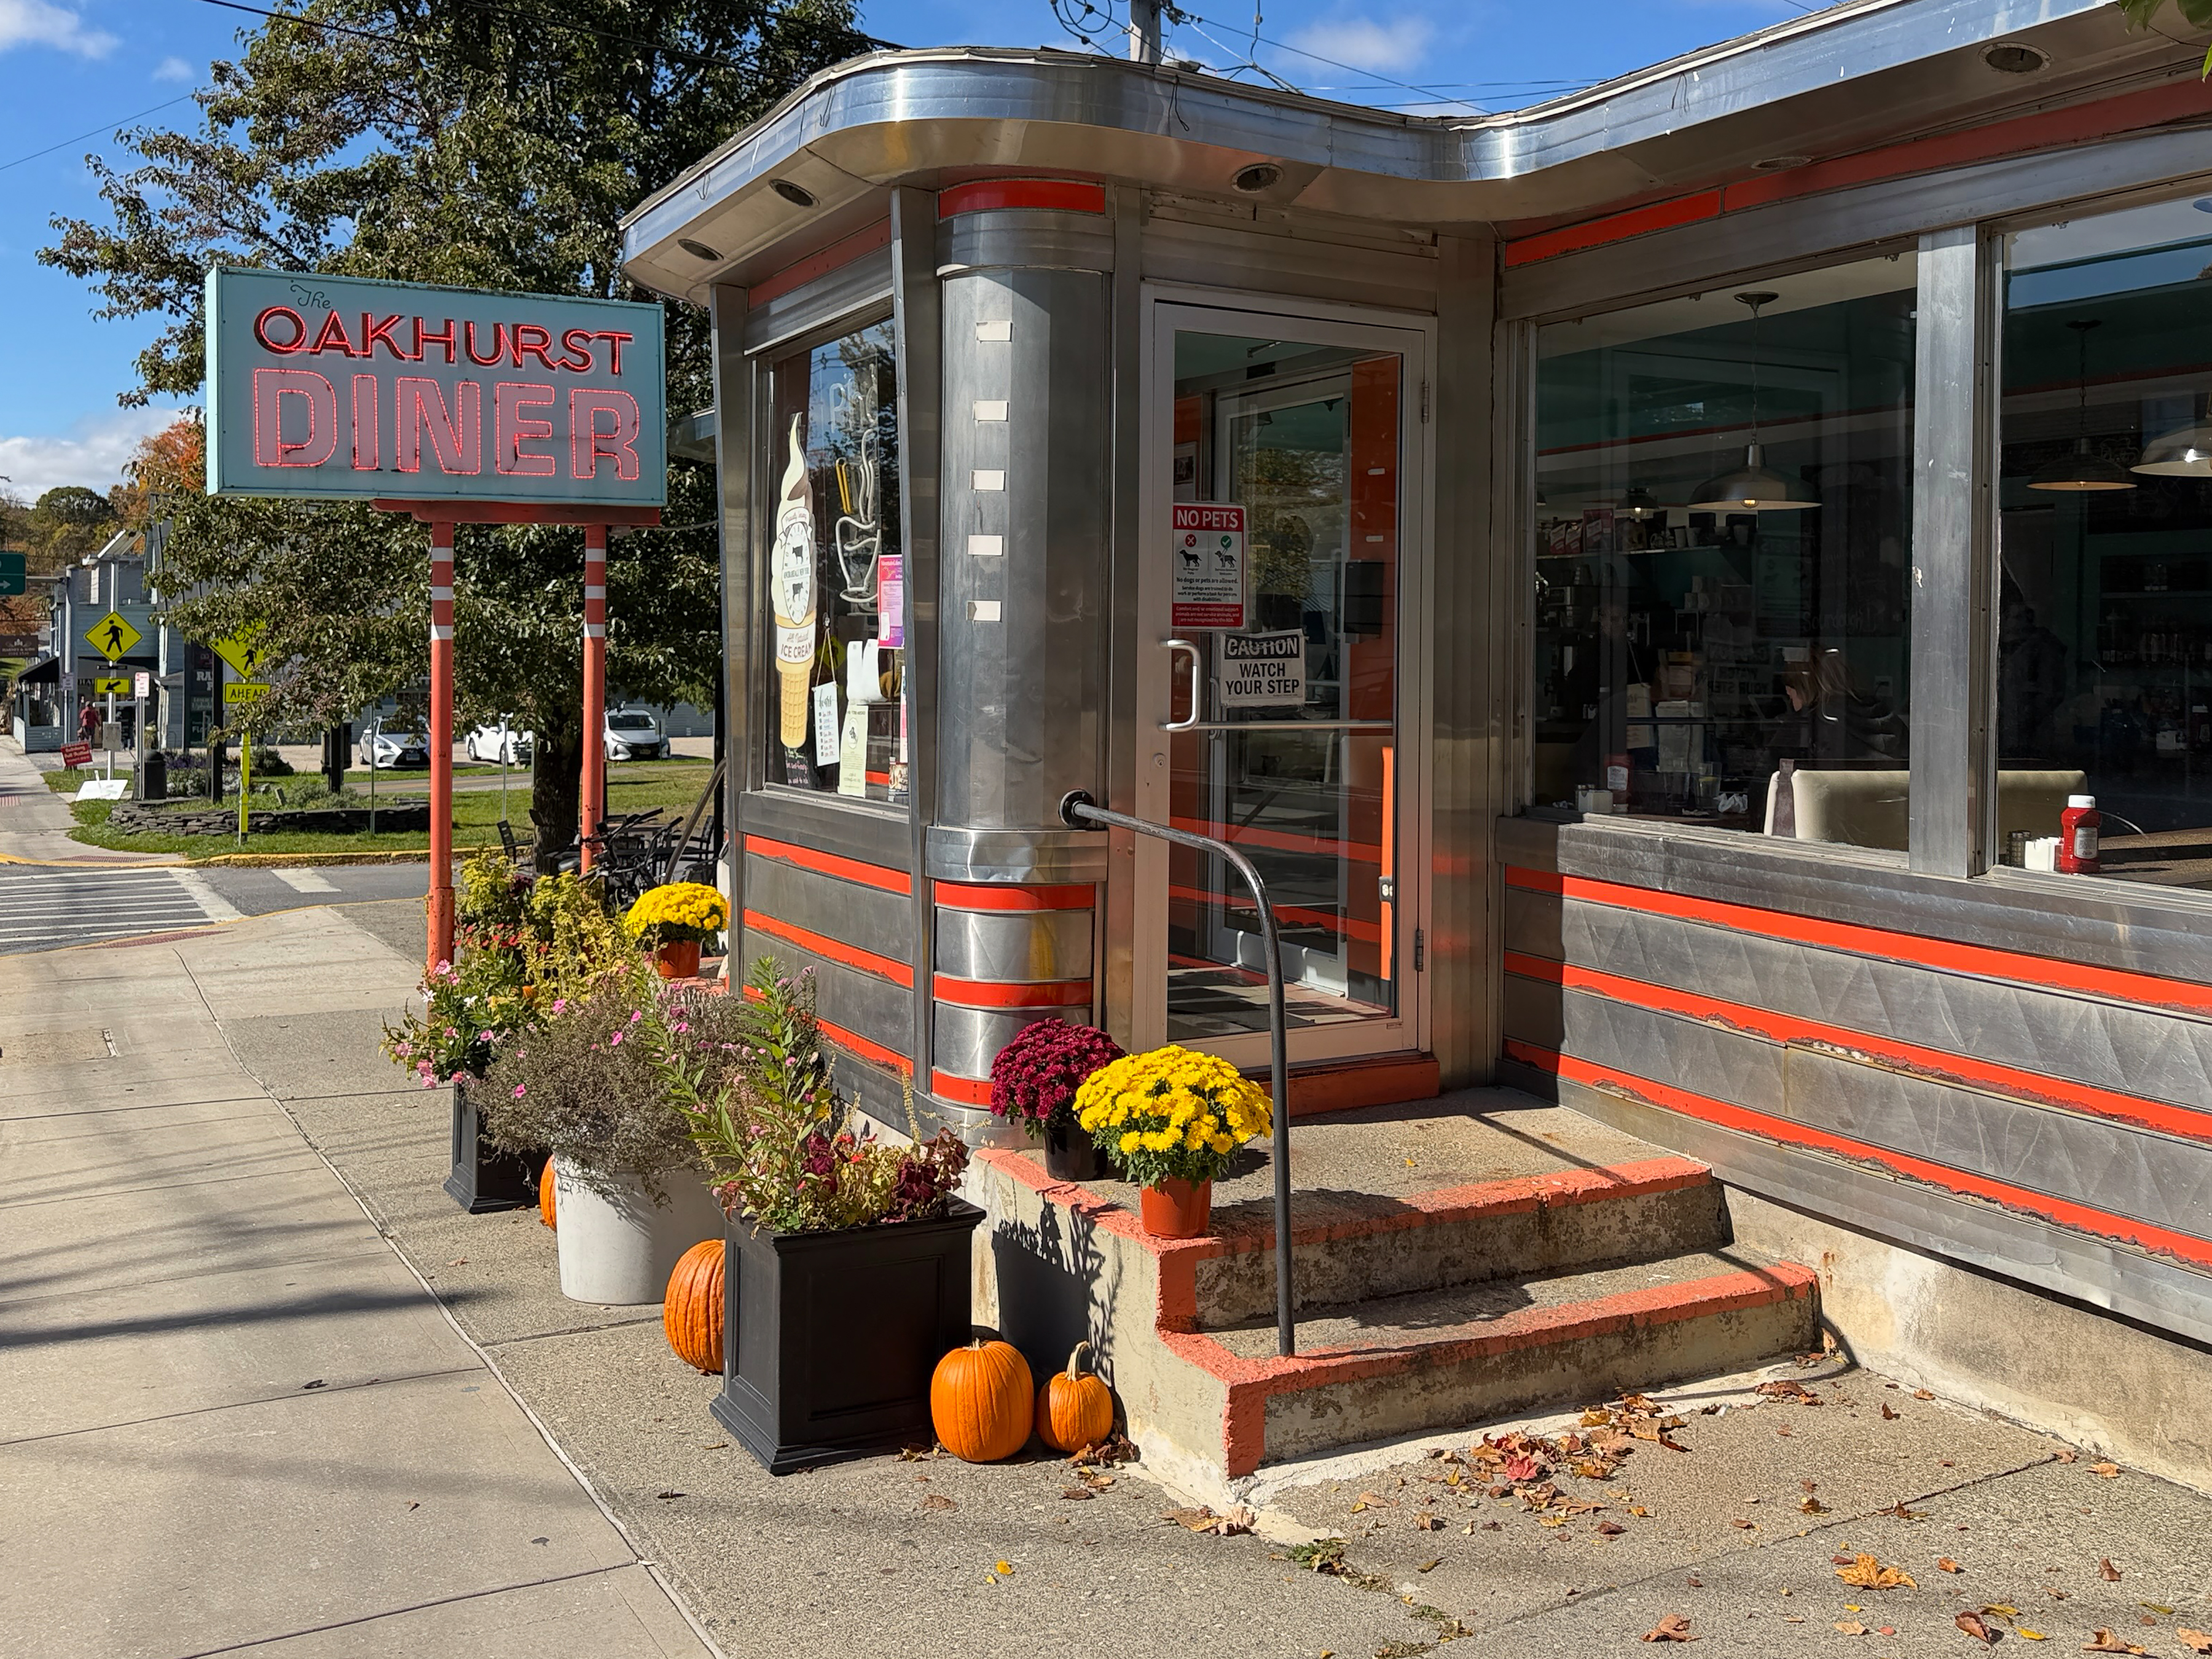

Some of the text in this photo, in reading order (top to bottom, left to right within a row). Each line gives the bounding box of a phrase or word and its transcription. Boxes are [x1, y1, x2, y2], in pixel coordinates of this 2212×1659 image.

[290, 284, 331, 309] The
[254, 306, 633, 375] OAKHURST
[253, 369, 640, 480] DINER
[1177, 509, 1238, 528] NO PETS
[780, 639, 812, 659] ICE CREAM
[1227, 637, 1298, 656] CAUTION
[1239, 662, 1285, 678] WATCH
[1225, 679, 1300, 695] YOUR STEP
